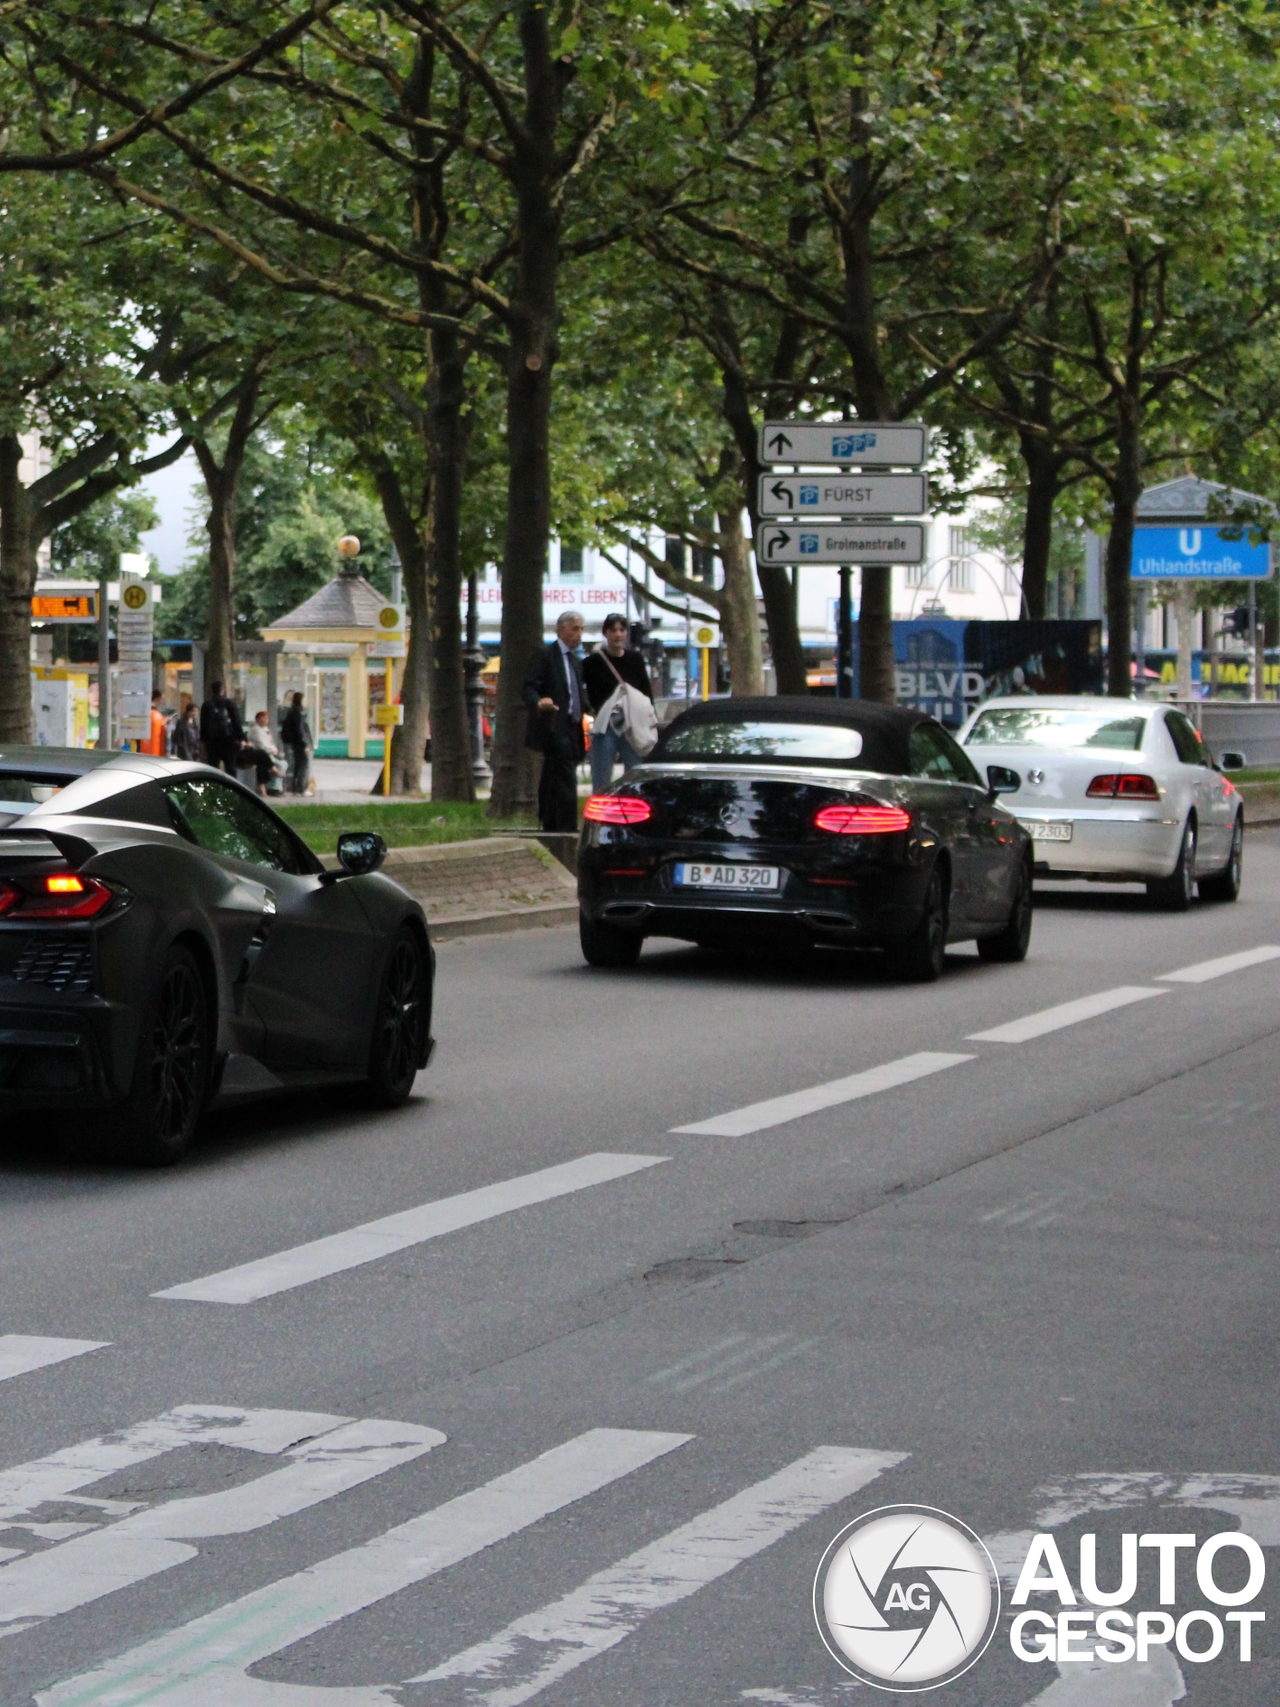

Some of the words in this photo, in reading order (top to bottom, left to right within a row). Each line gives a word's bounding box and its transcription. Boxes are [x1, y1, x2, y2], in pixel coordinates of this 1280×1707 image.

[824, 486, 873, 502] FÜRST
[826, 537, 907, 551] Grolmanstraße
[1179, 528, 1202, 556] U
[1139, 556, 1242, 574] Uhlandstraße
[580, 589, 626, 604] LEBENS
[894, 671, 985, 698] BLVD
[1038, 826, 1069, 838] 2303
[690, 866, 701, 883] B
[714, 867, 736, 884] AD
[738, 868, 771, 886] 320
